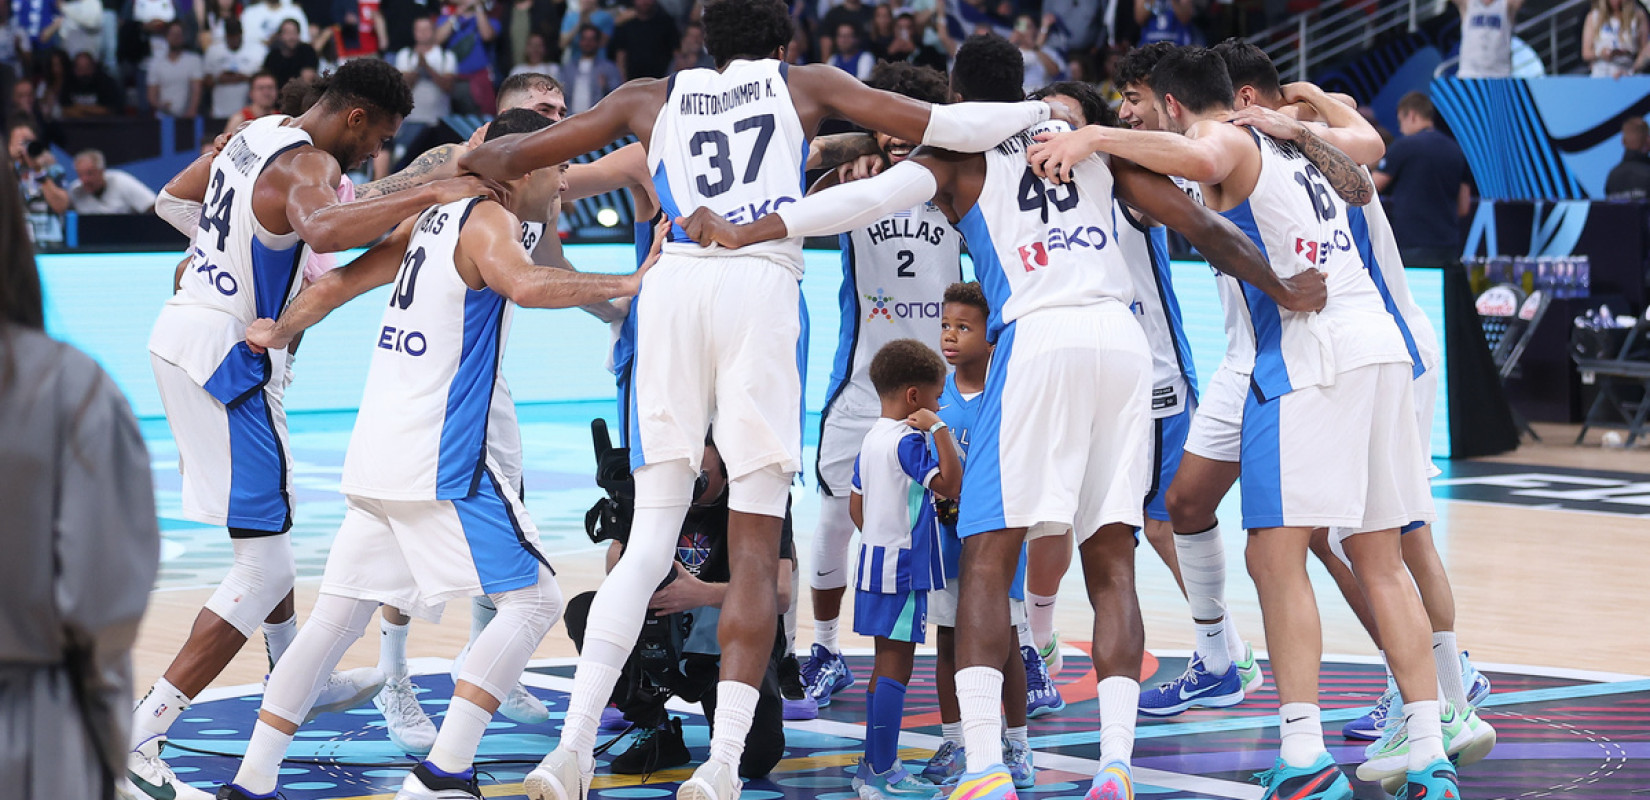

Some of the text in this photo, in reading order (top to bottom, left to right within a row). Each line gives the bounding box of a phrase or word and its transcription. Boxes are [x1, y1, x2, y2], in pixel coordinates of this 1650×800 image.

[766, 78, 776, 98] K.
[689, 113, 776, 198] 37
[1294, 163, 1337, 224] 16
[199, 168, 235, 252] 24
[867, 219, 945, 245] HELLAS
[1048, 226, 1107, 251] EKO
[897, 250, 916, 278] 2
